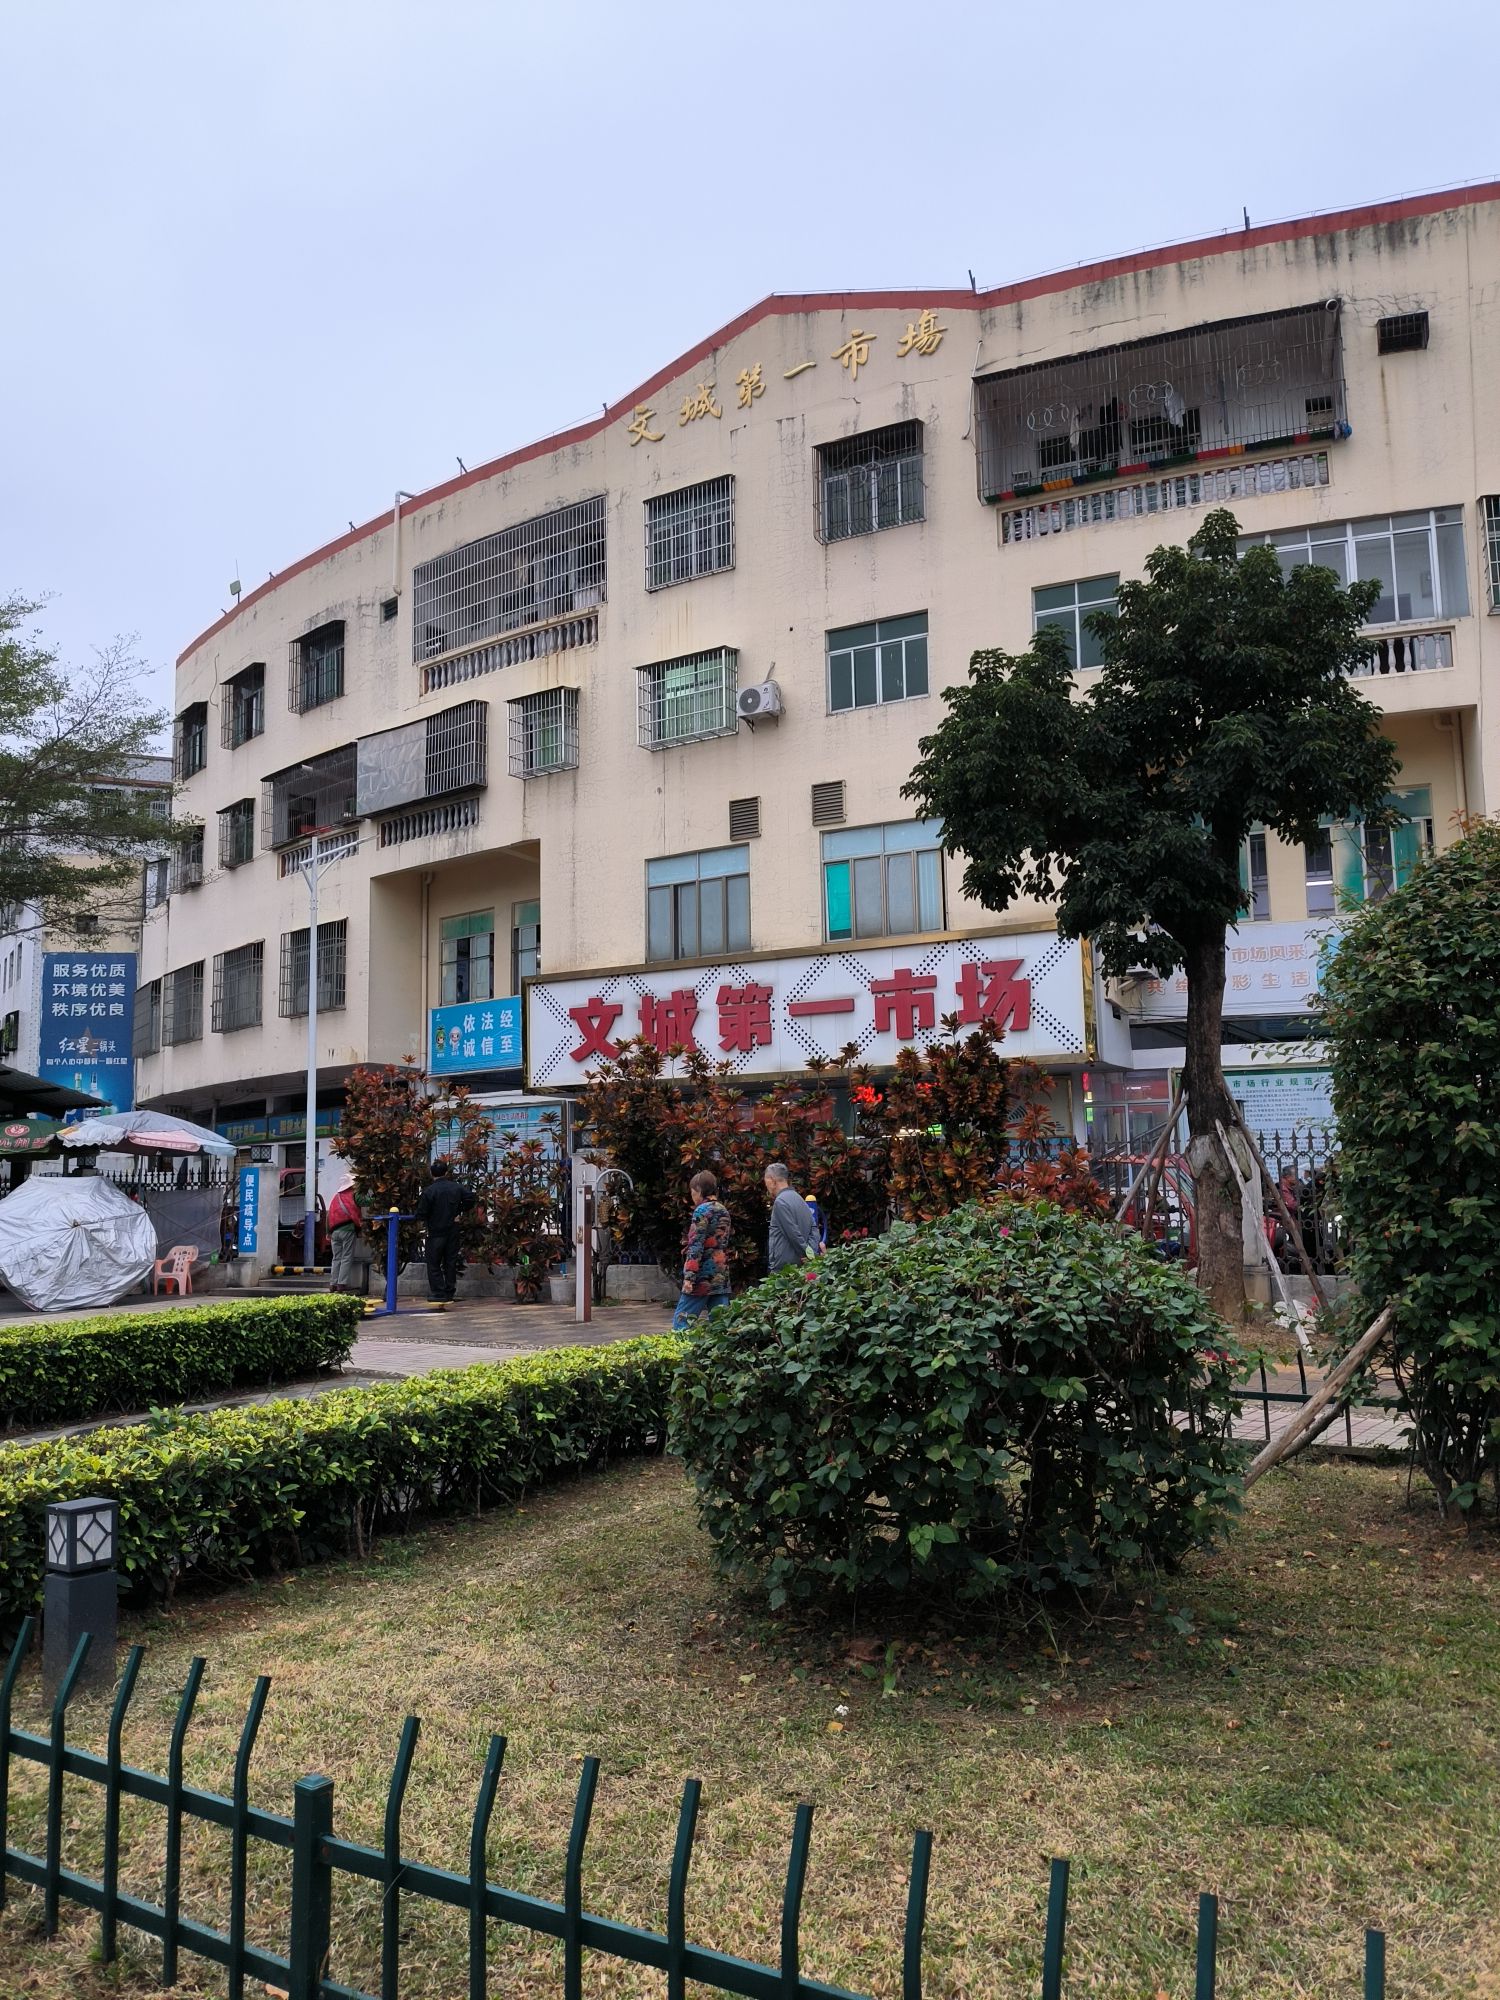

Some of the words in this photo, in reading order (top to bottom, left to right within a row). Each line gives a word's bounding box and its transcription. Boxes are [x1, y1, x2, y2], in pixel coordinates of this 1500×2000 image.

[627, 309, 948, 447] 文城第一市場
[52, 963, 127, 979] 服务优质
[52, 982, 126, 998] 环境优美
[51, 1002, 126, 1018] 秩序优良
[568, 958, 1032, 1063] 文城第一市场
[242, 1174, 255, 1247] 便民疏导点
